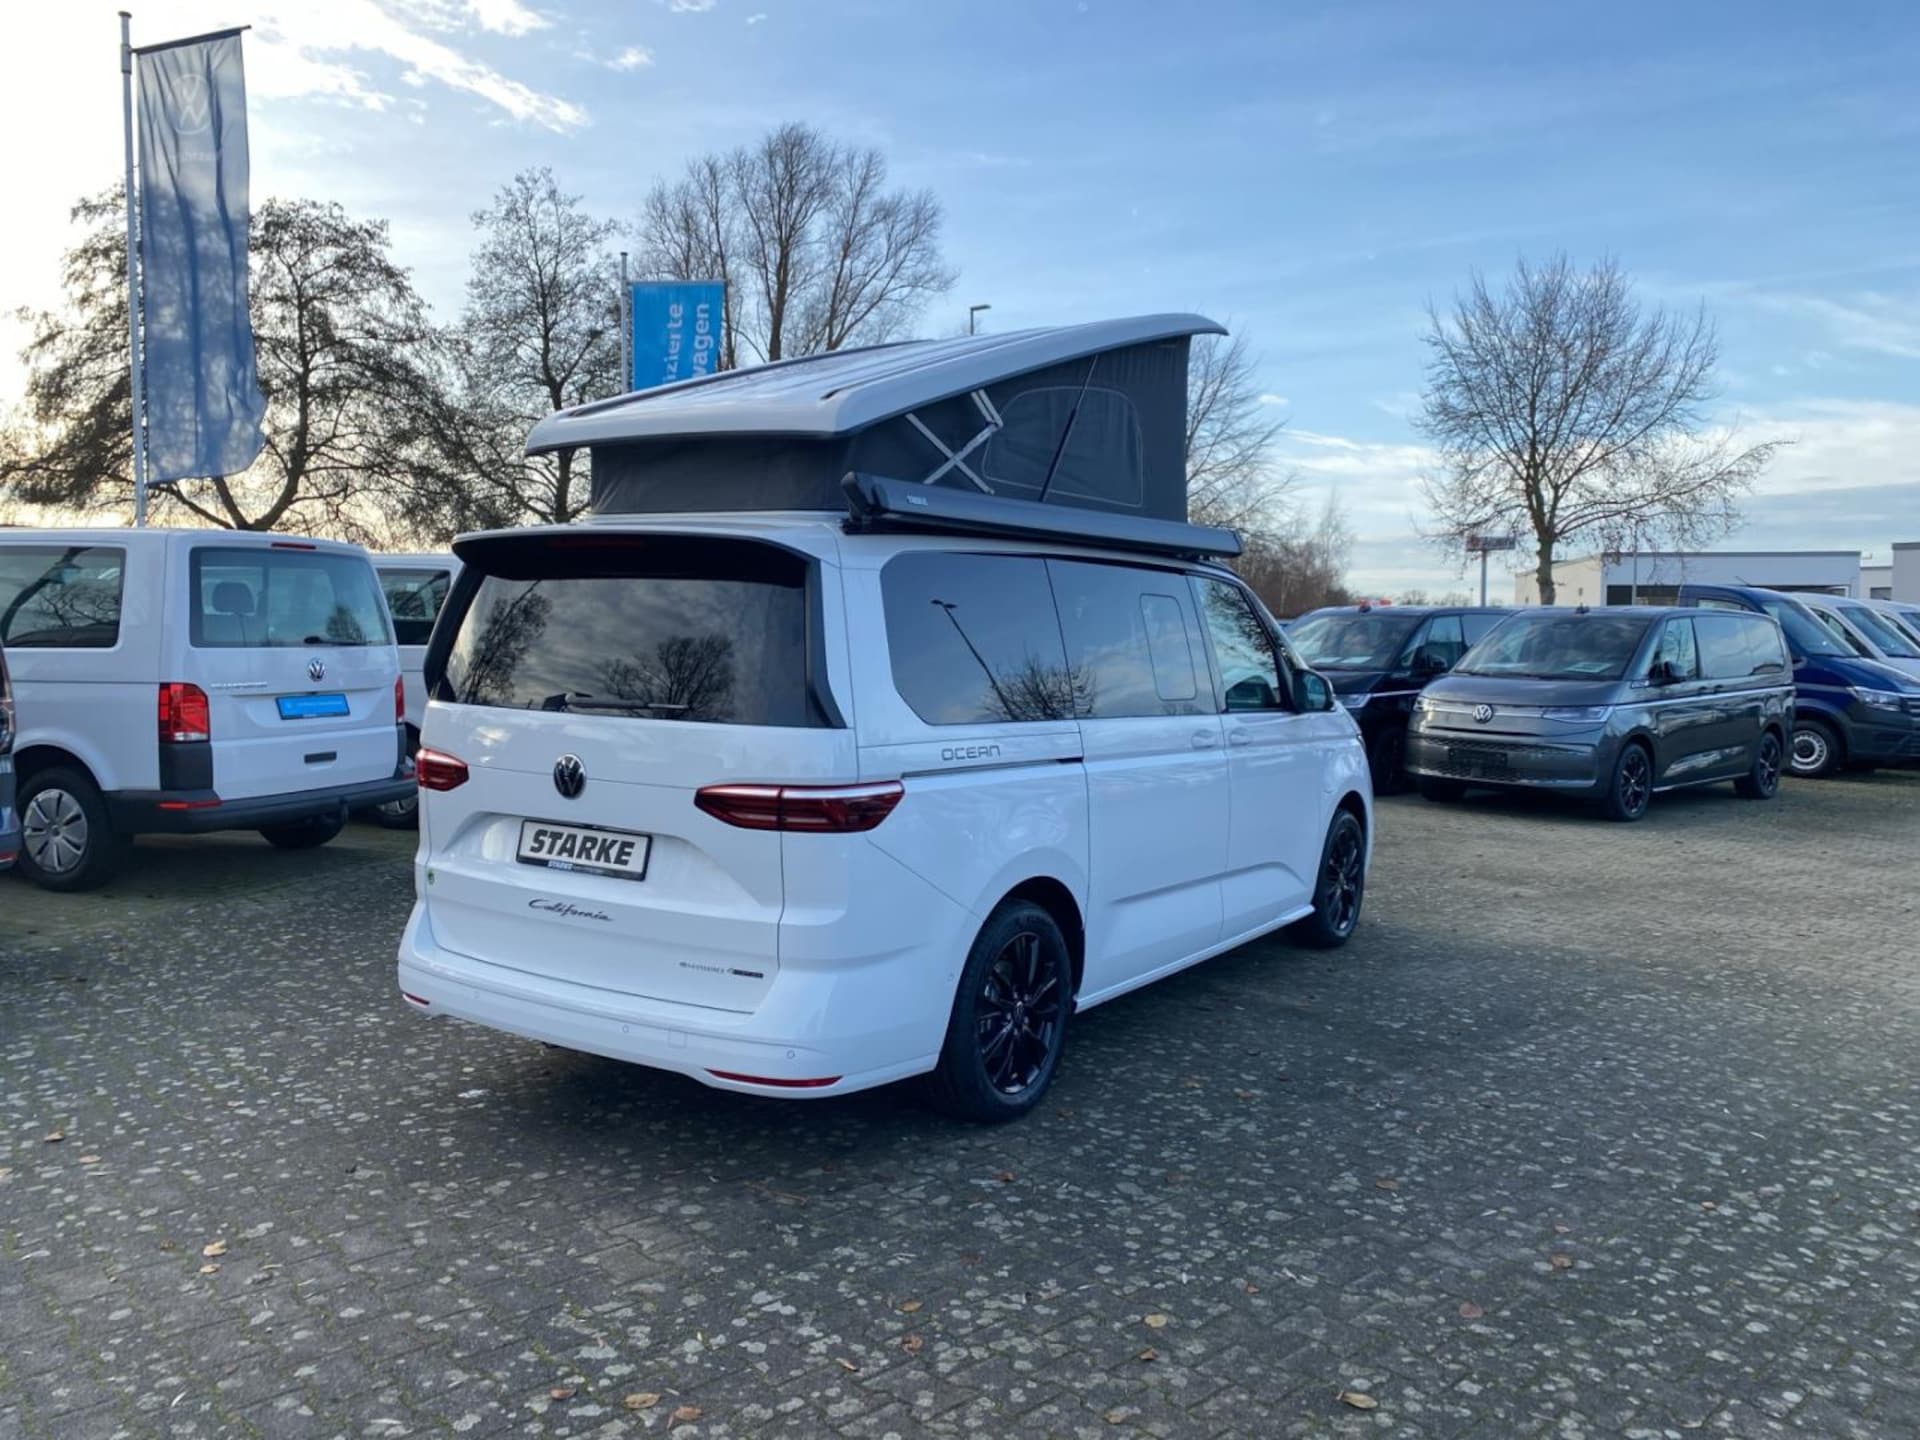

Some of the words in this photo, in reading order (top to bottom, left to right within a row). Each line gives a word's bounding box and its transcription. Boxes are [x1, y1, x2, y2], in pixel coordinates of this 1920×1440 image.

[942, 745, 1000, 761] OCEAN
[529, 829, 635, 866] STARKE
[528, 899, 614, 921] California
